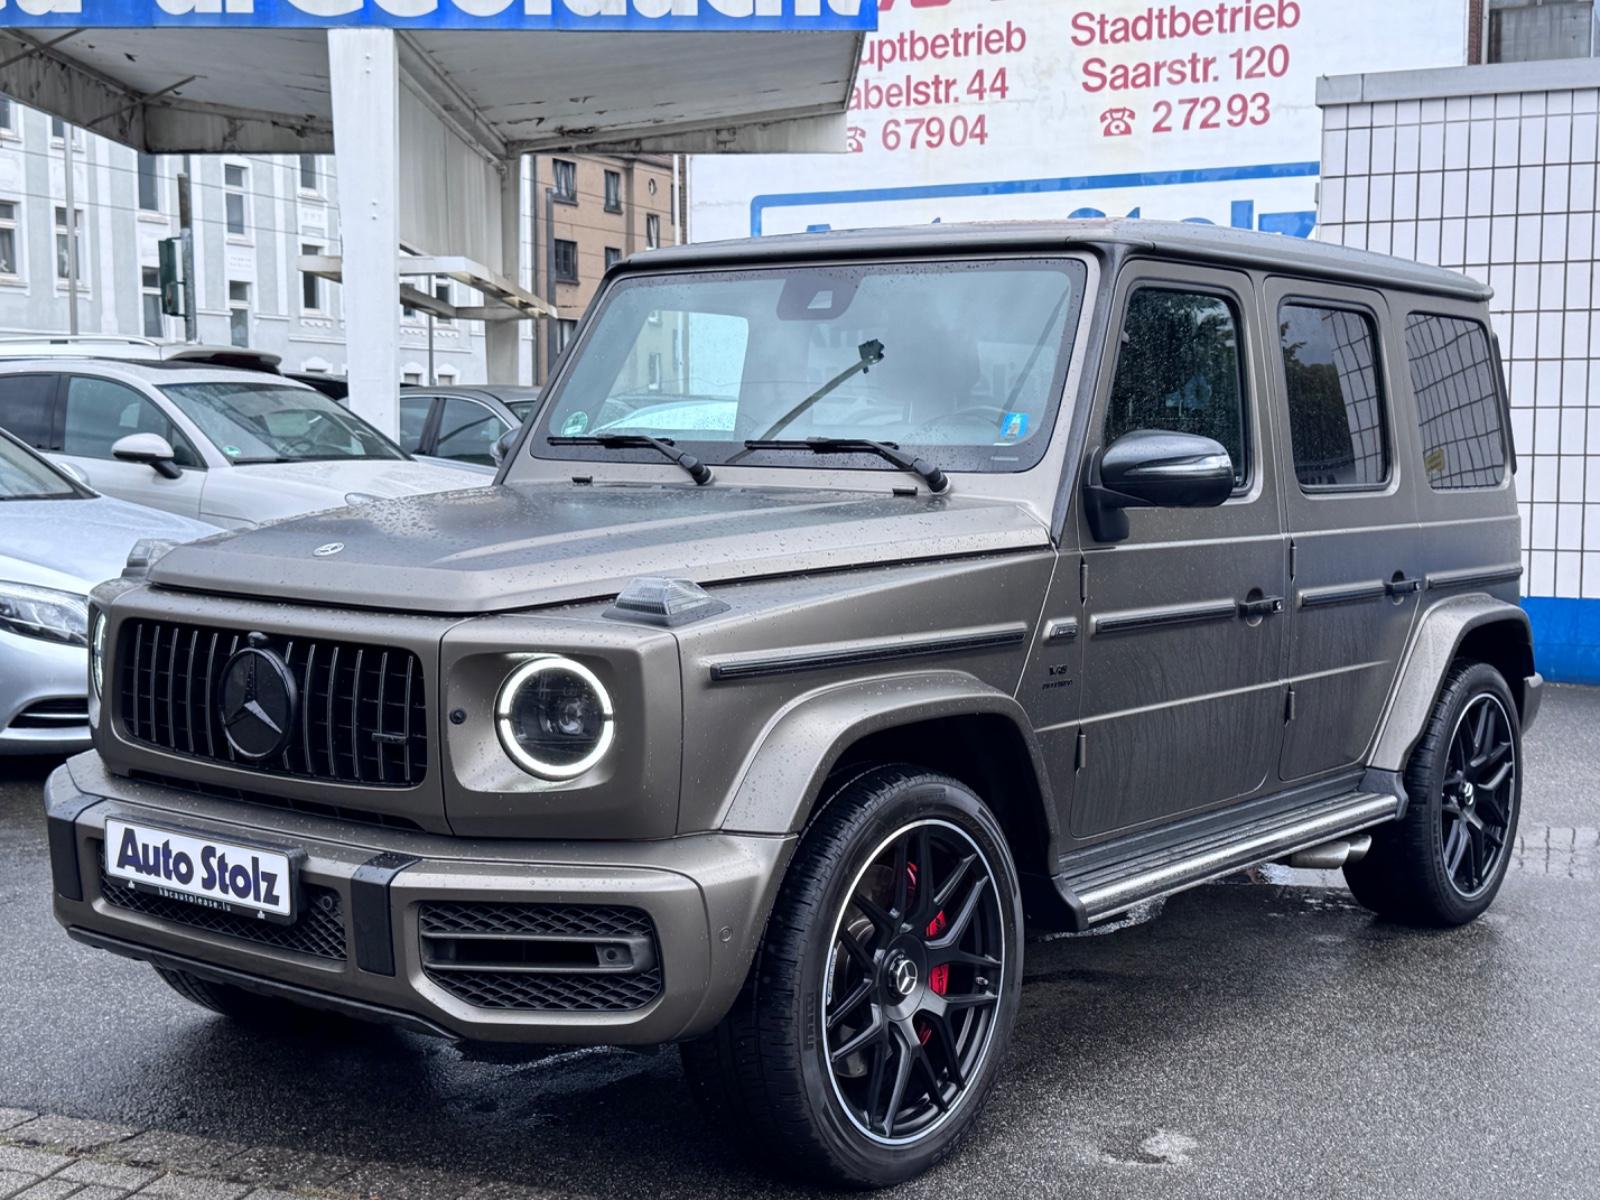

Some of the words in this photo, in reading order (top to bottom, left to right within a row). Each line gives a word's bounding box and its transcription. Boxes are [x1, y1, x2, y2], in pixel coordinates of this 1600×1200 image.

[860, 21, 1026, 72] uptbetrieb
[1070, 0, 1301, 47] Stadtbetrieb
[849, 74, 960, 110] abelstr.
[966, 67, 1009, 101] 44
[1081, 53, 1220, 94] Saarstr.
[1230, 43, 1290, 80] 120
[116, 827, 194, 885] Auto
[201, 845, 280, 906] Stolz
